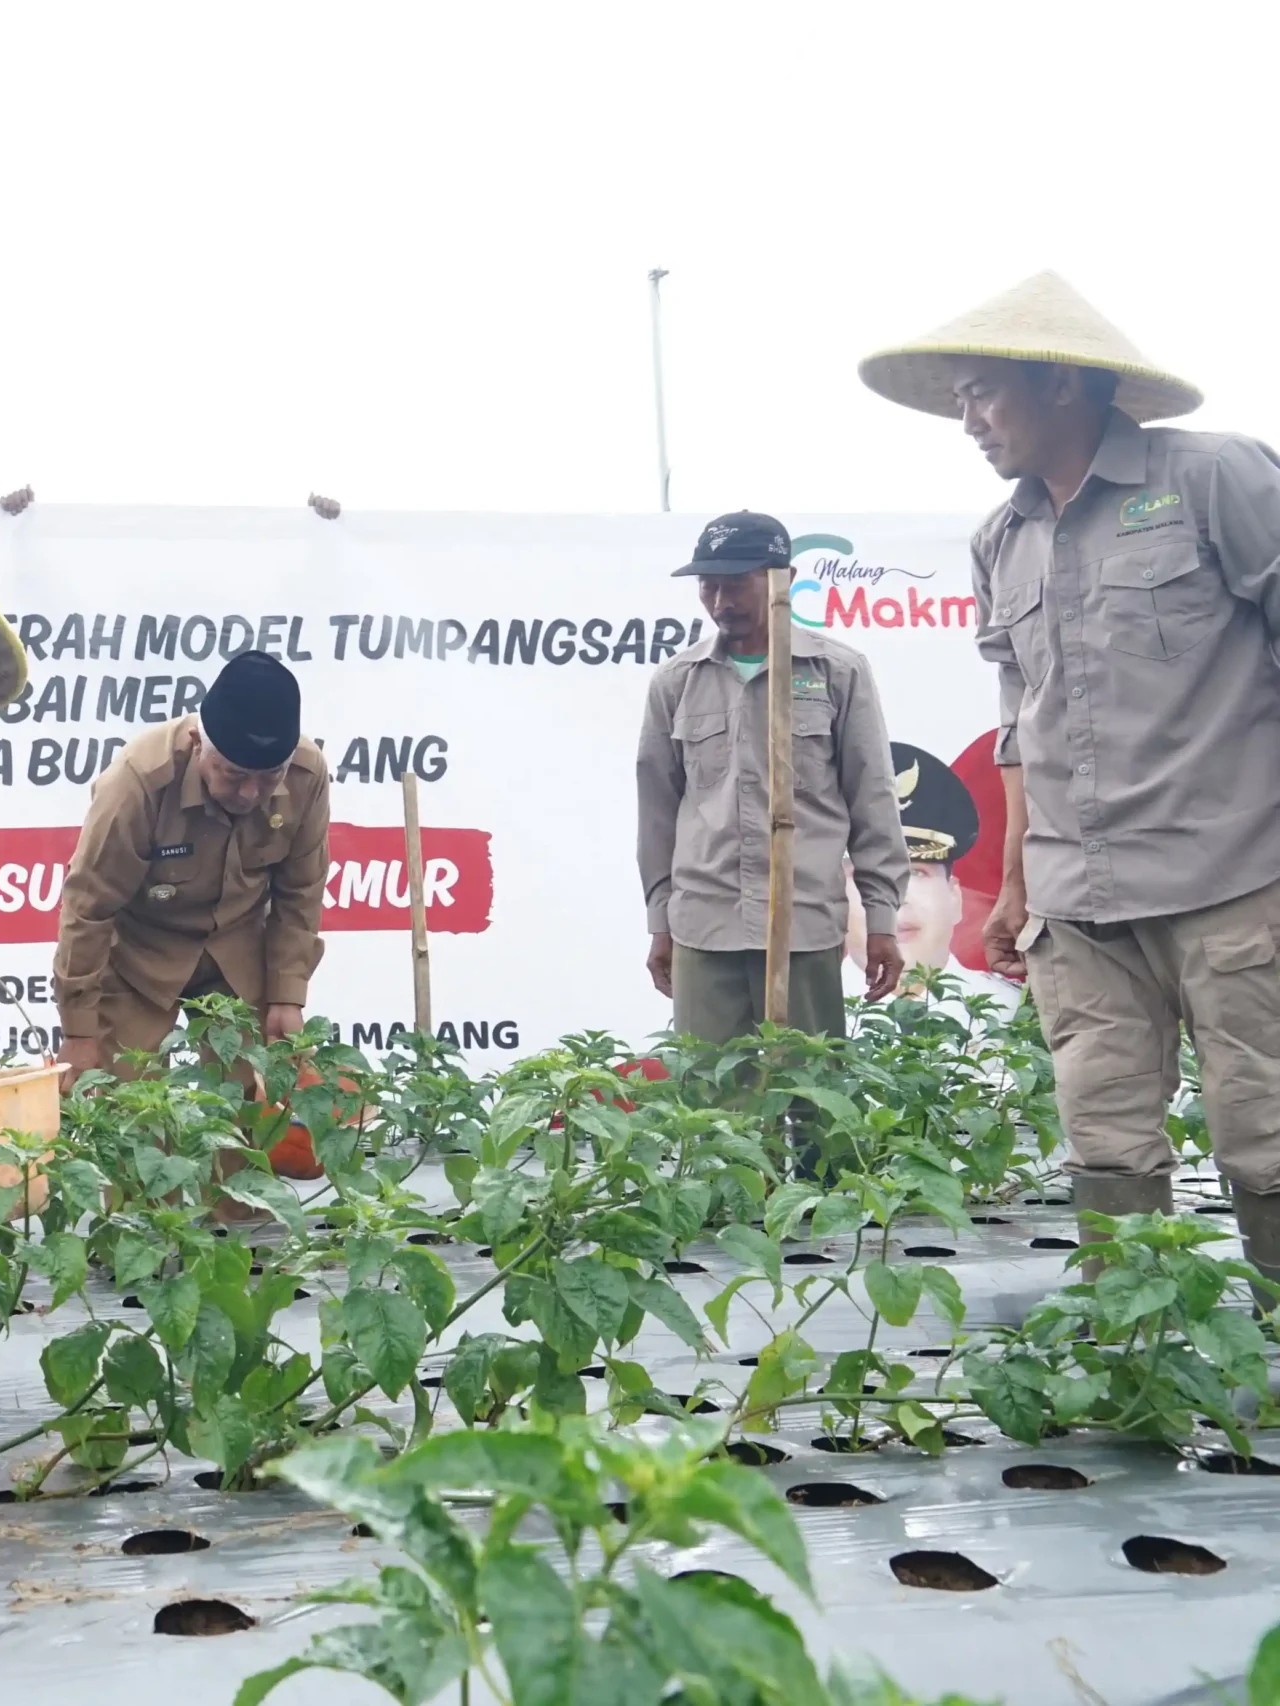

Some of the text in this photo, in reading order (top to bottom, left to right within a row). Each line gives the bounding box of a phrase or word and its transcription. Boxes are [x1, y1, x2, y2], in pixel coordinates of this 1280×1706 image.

[814, 557, 937, 586] Malang
[825, 586, 979, 629] Makm
[3, 613, 126, 661] RAH
[134, 614, 312, 662] MODEL
[329, 614, 704, 665] TUMPANGSARI
[96, 675, 210, 723] MER
[314, 735, 448, 784] ANG
[161, 846, 187, 857] SANUSI
[321, 857, 460, 909] KMUR
[352, 1020, 520, 1051] MAANG
